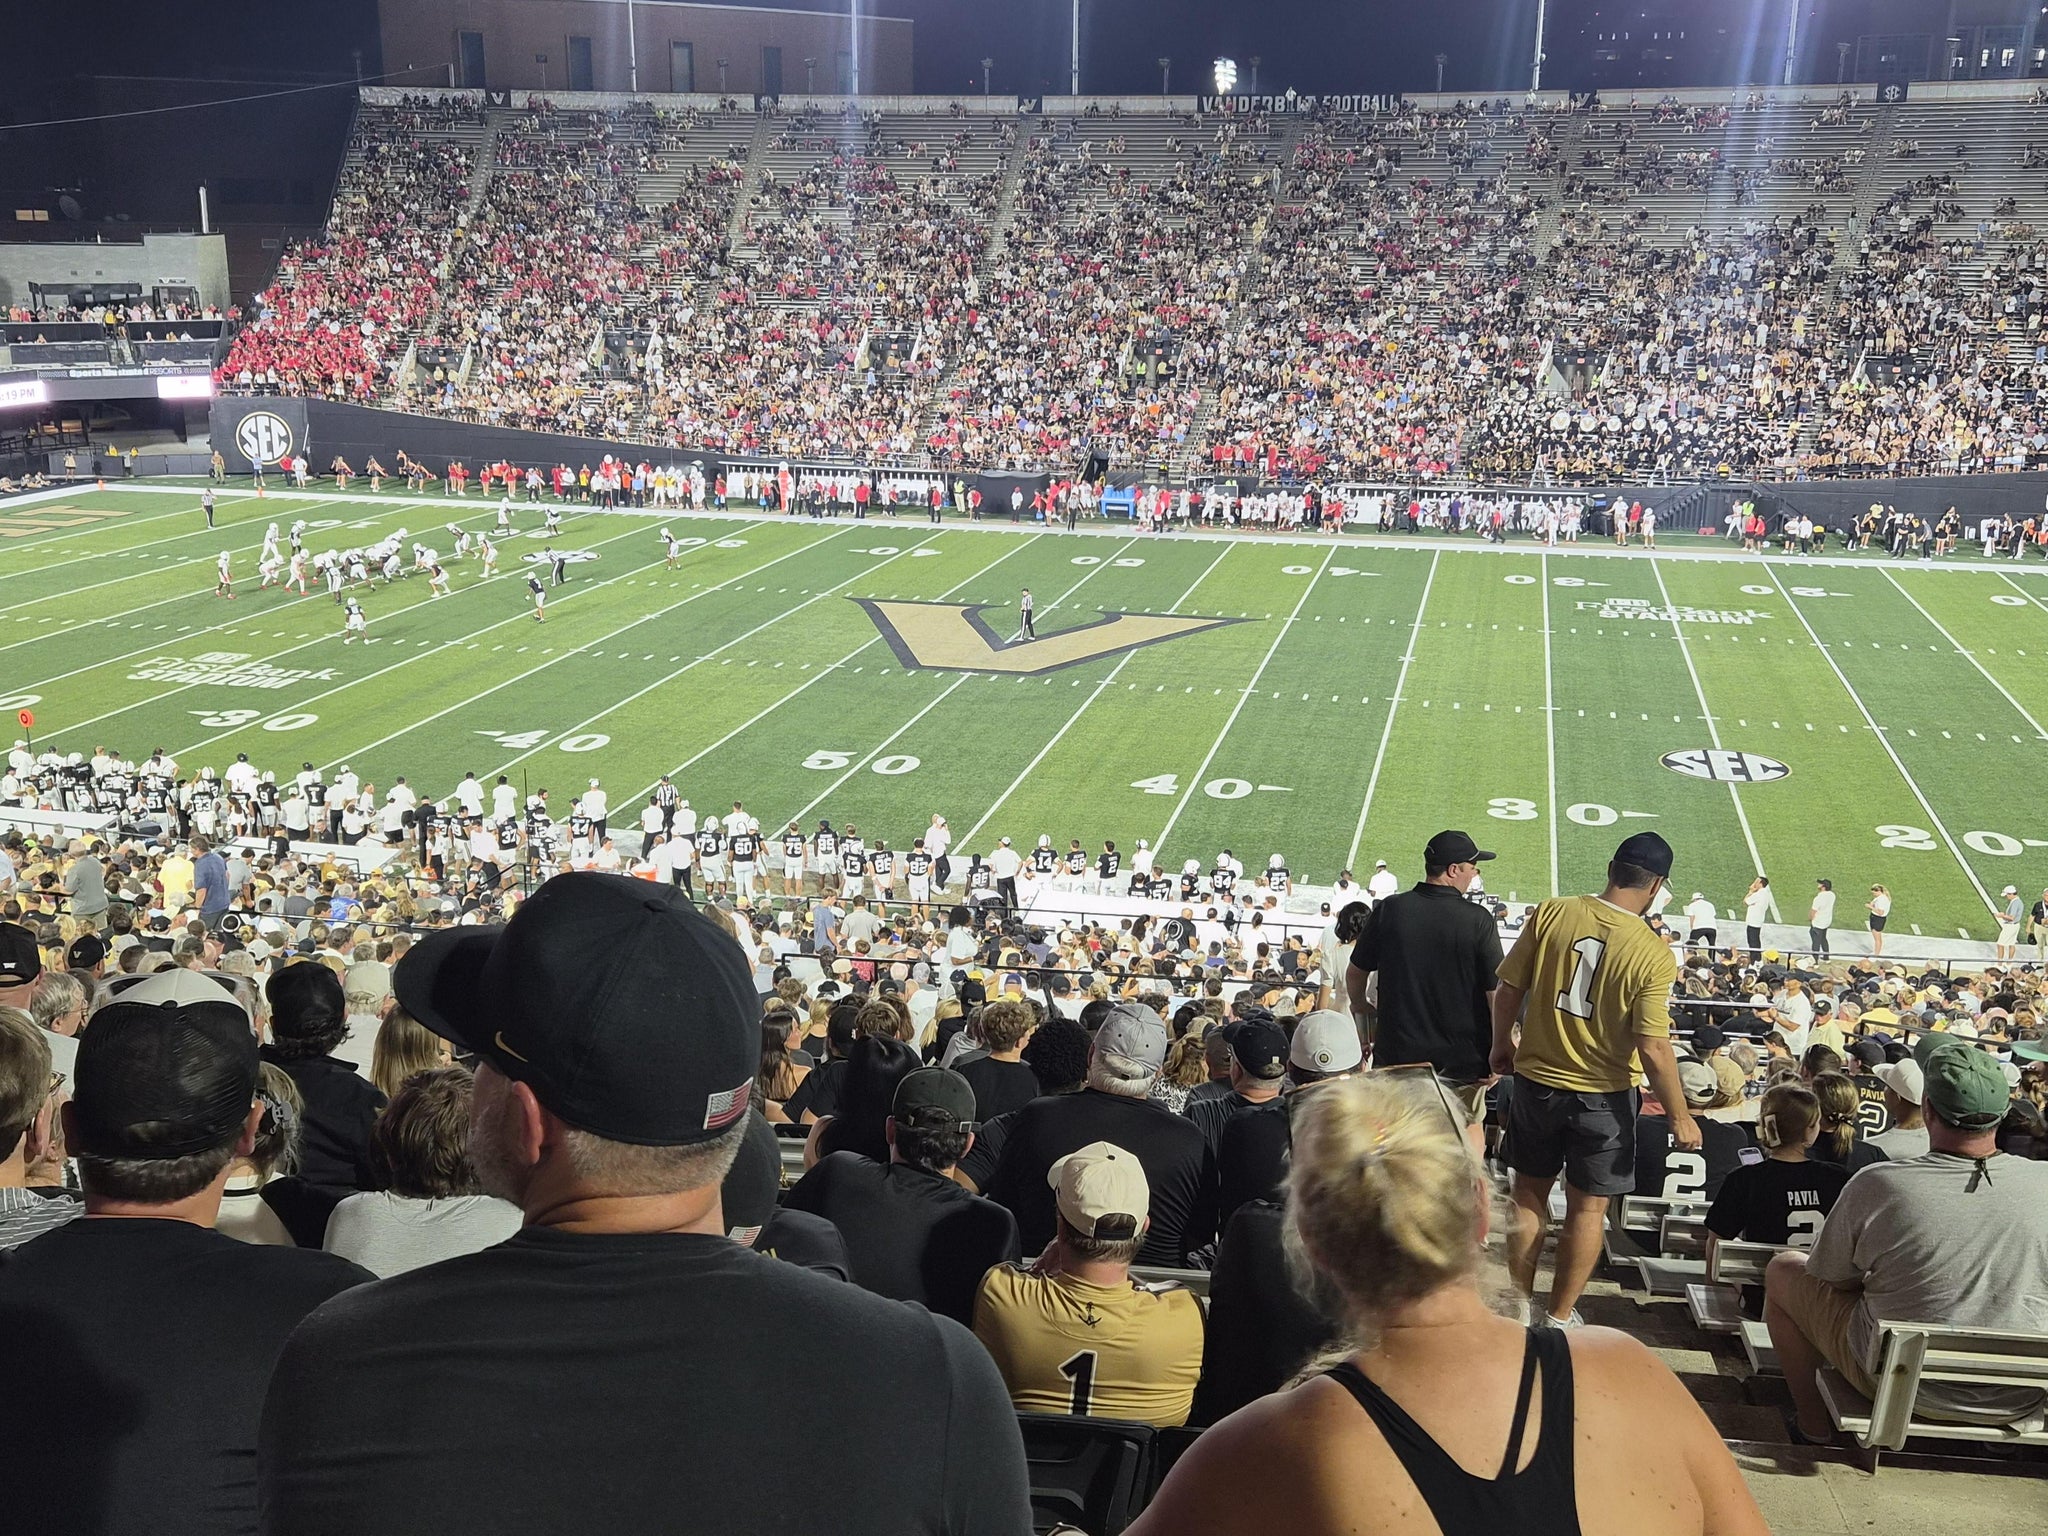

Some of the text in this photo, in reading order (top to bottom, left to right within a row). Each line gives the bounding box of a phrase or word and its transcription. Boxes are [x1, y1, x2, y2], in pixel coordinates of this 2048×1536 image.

[490, 92, 505, 105] V
[1202, 95, 1317, 112] VANDERBLT
[240, 415, 288, 461] SEC
[1575, 601, 1775, 619] FirstBank
[1598, 610, 1754, 625] STADIUM
[844, 596, 1266, 676] V
[130, 656, 345, 681] FirstBank
[126, 669, 300, 689] STADIUM
[800, 749, 921, 775] 50
[1665, 750, 1786, 782] SEC
[1130, 773, 1254, 800] 40
[1486, 797, 1620, 827] 30
[501, 830, 517, 845] 37
[700, 837, 718, 853] 73
[1875, 824, 2024, 857] 20
[909, 861, 929, 874] 82
[1036, 856, 1053, 870] 14
[1107, 860, 1119, 874] 2
[1152, 888, 1171, 901] 57
[1556, 936, 1607, 1021] 1
[1860, 1087, 1886, 1102] PAVIA
[1661, 1151, 1707, 1201] 2
[1786, 1189, 1820, 1207] PAVIA
[1057, 1349, 1099, 1417] 1
